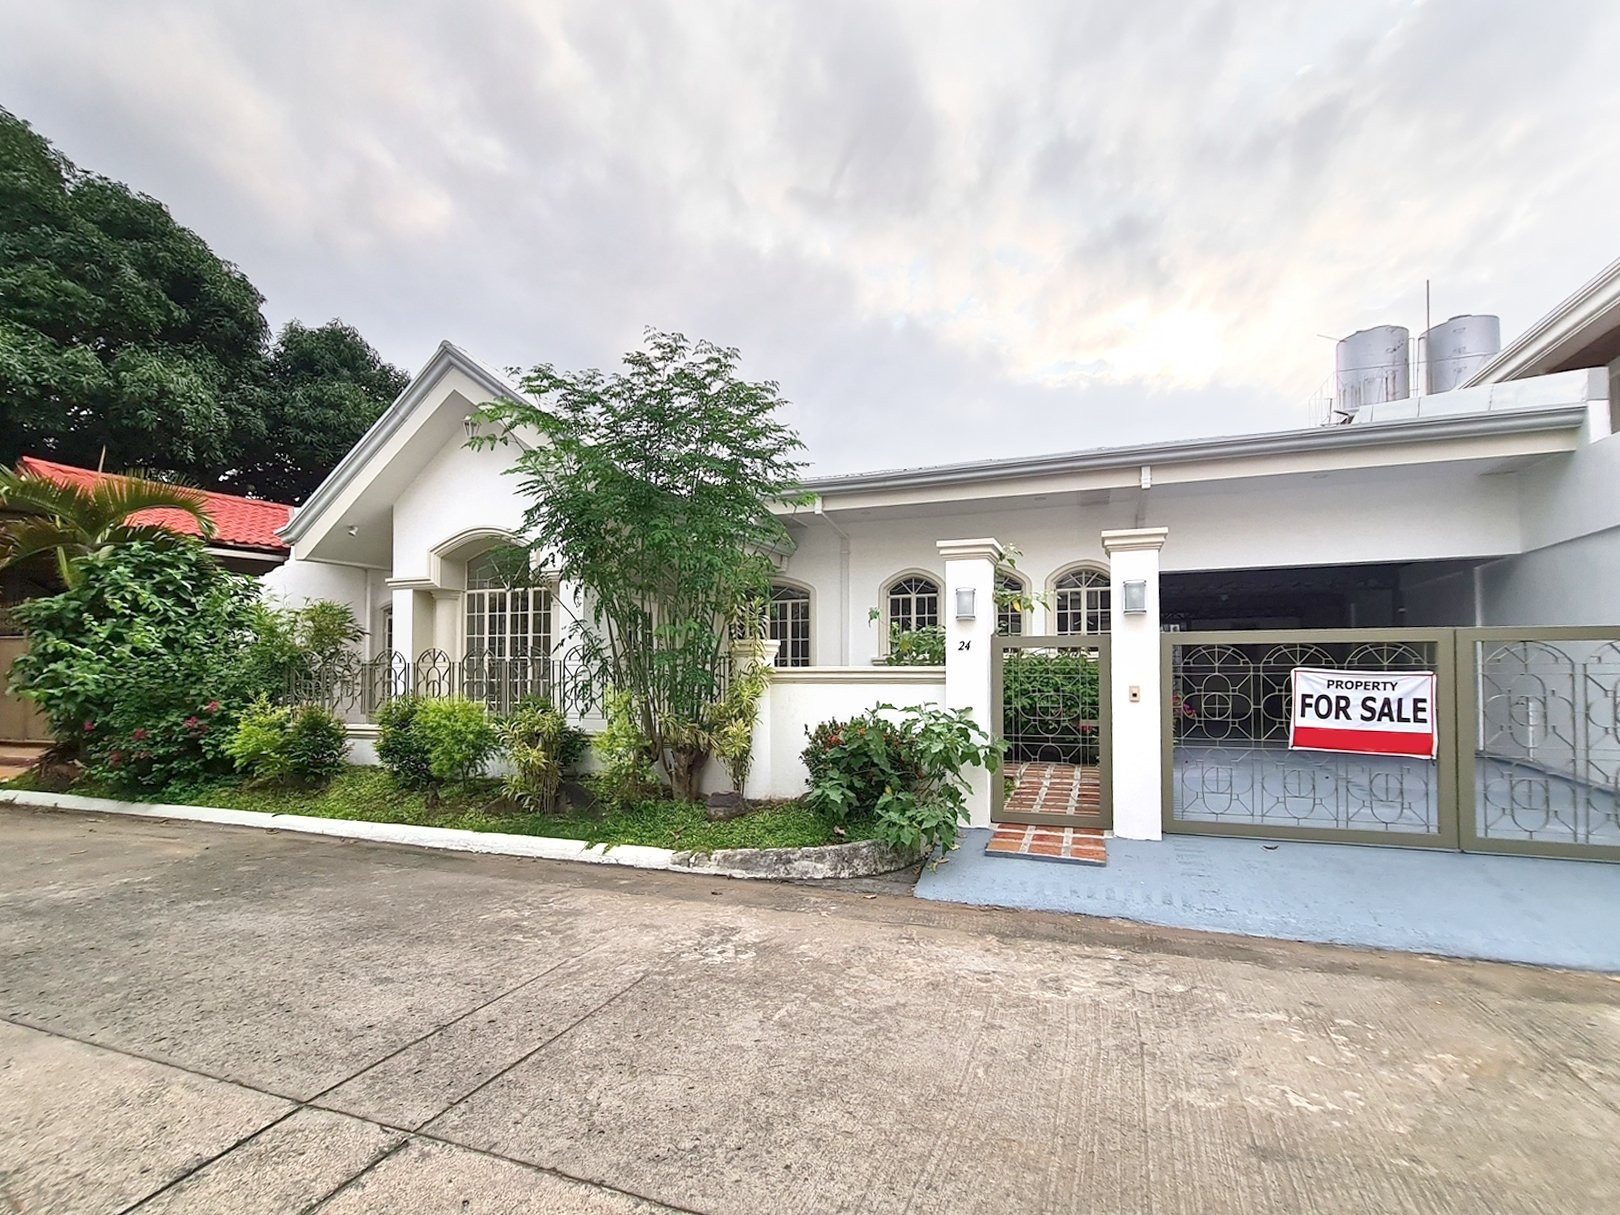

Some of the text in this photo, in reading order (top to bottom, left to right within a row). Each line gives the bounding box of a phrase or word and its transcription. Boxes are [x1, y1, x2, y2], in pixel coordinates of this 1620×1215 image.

[958, 640, 972, 651] 24
[1327, 680, 1398, 691] PROPERTY
[1300, 694, 1428, 723] FOR SALE
